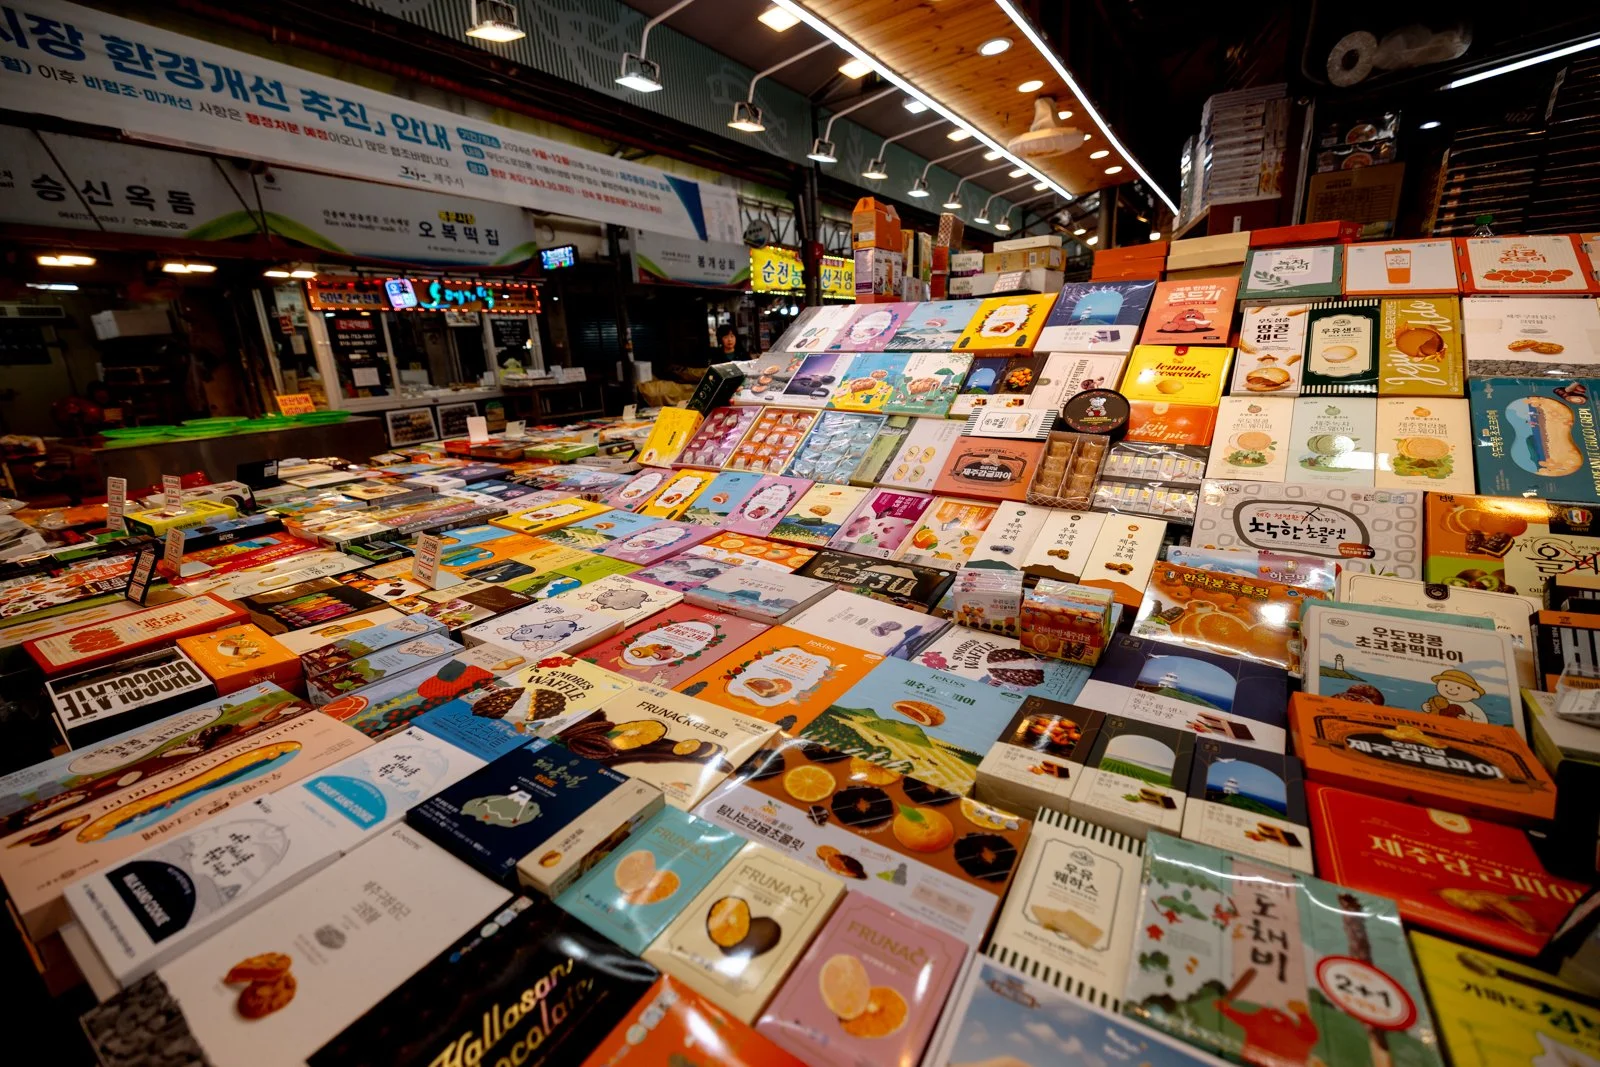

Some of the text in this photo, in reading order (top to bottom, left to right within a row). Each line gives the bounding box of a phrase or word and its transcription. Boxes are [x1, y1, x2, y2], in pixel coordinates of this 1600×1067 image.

[39, 63, 78, 85] 이후
[100, 31, 292, 113] 환경개선
[391, 113, 452, 150] 안내
[419, 221, 500, 247] 오복떡집
[1255, 334, 1289, 343] 샌드
[1257, 324, 1290, 334] 땅콩
[1155, 362, 1196, 371] lemon
[1385, 350, 1447, 386] Jeju
[962, 468, 1012, 480] 제주감귤파이
[1249, 517, 1346, 543] 착한 초콜렛
[1184, 572, 1225, 589] 한라봉
[1356, 636, 1464, 663] 초코찰떡파이
[1372, 627, 1443, 647] 우도땅콩
[964, 641, 1000, 671] WAFFLE
[56, 660, 203, 721] CHOCOLATE
[527, 675, 587, 702] WAFFLE
[549, 670, 594, 691] S'MORES
[1373, 714, 1439, 730] ORIGINAL
[1347, 739, 1504, 779] 제주감귤파이
[716, 803, 805, 852] 탐나는감귤초콜릿
[1064, 862, 1094, 882] 우유
[1369, 834, 1584, 904] 제주당근파이
[1053, 870, 1099, 896] 웨하스
[1335, 974, 1391, 1008] 2+1
